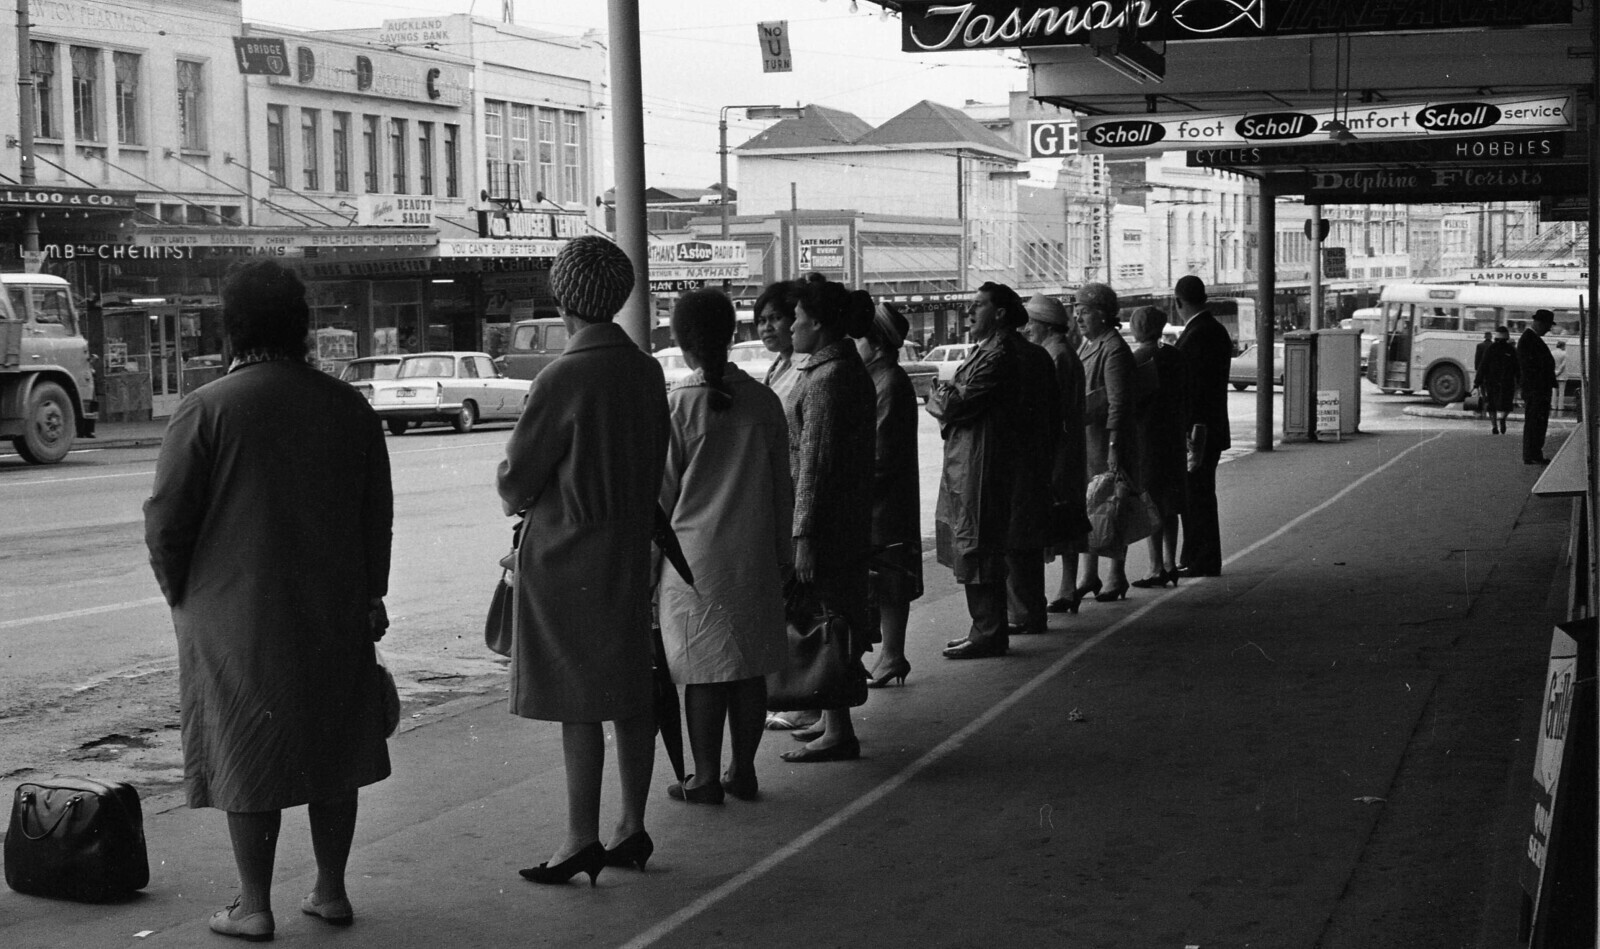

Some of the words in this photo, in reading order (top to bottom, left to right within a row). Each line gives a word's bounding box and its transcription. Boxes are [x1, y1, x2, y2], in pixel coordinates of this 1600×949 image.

[29, 0, 76, 22] EWTON
[388, 19, 442, 31] AUCKLAND
[909, 0, 1158, 50] Tasman
[379, 32, 420, 44] SAVINGS
[423, 31, 449, 42] BANK
[763, 27, 782, 37] NO
[247, 43, 283, 56] BRIDGE
[768, 40, 782, 57] U
[765, 59, 790, 69] TURN
[1094, 124, 1152, 145] Scholl
[1178, 121, 1225, 138] foot
[1243, 116, 1304, 136] Scholl
[1423, 106, 1488, 128] Scholl
[1503, 105, 1562, 120] service
[1456, 140, 1552, 156] HOBBIES
[1195, 148, 1261, 164] CYCLES
[1312, 171, 1418, 193] Delphine
[1431, 168, 1543, 189] Florists
[70, 195, 82, 204] &
[87, 194, 118, 206] CO.
[397, 199, 432, 210] BEAUTY
[402, 213, 431, 224] SALON
[266, 237, 295, 245] CHEMIST
[20, 244, 75, 259] LMB
[210, 246, 286, 257] OPTICIANS
[452, 244, 465, 254] YOU
[492, 244, 506, 254] BUY
[510, 244, 537, 254] BETTER
[678, 243, 712, 260] Astor
[714, 245, 733, 260] RADIO
[735, 245, 745, 260] TV
[801, 247, 810, 263] K
[812, 255, 844, 267] THURSDAY
[1470, 272, 1548, 280] LAMPHOUSE
[650, 281, 673, 291] HAN
